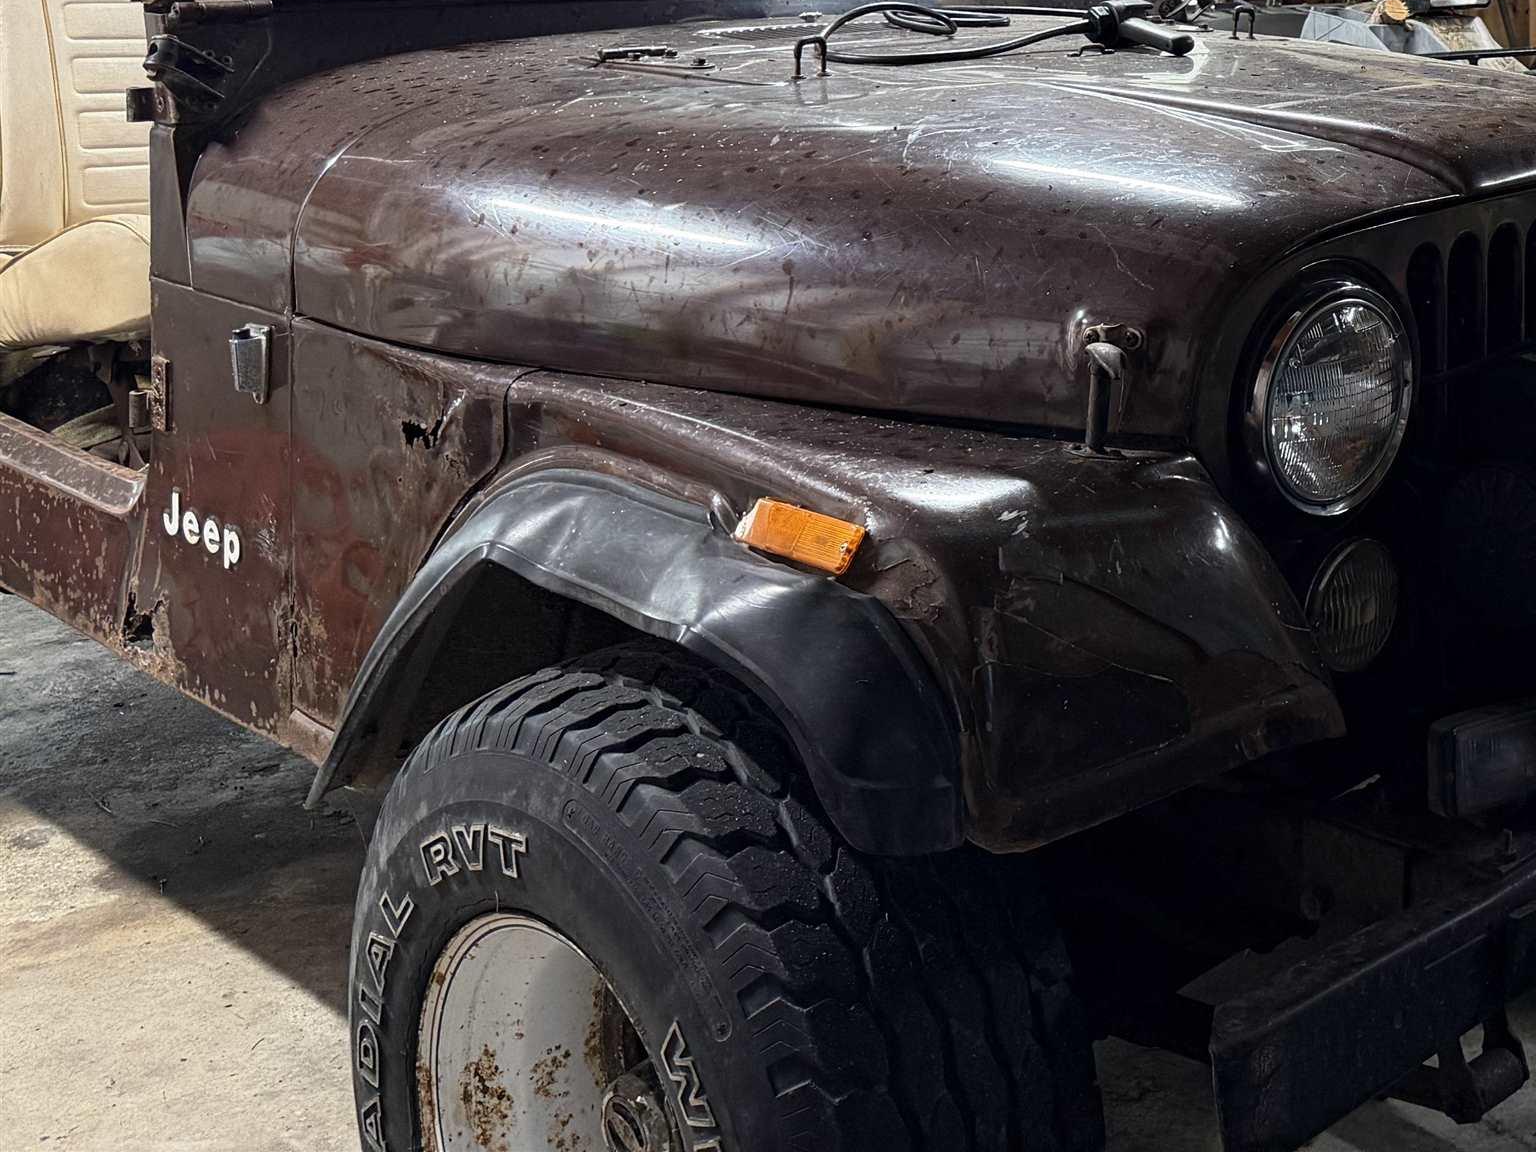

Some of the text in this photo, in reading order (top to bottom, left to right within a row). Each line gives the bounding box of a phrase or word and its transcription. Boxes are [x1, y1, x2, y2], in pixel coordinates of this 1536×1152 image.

[163, 490, 240, 569] Jeep
[357, 823, 527, 1152] ADIAL RVT
